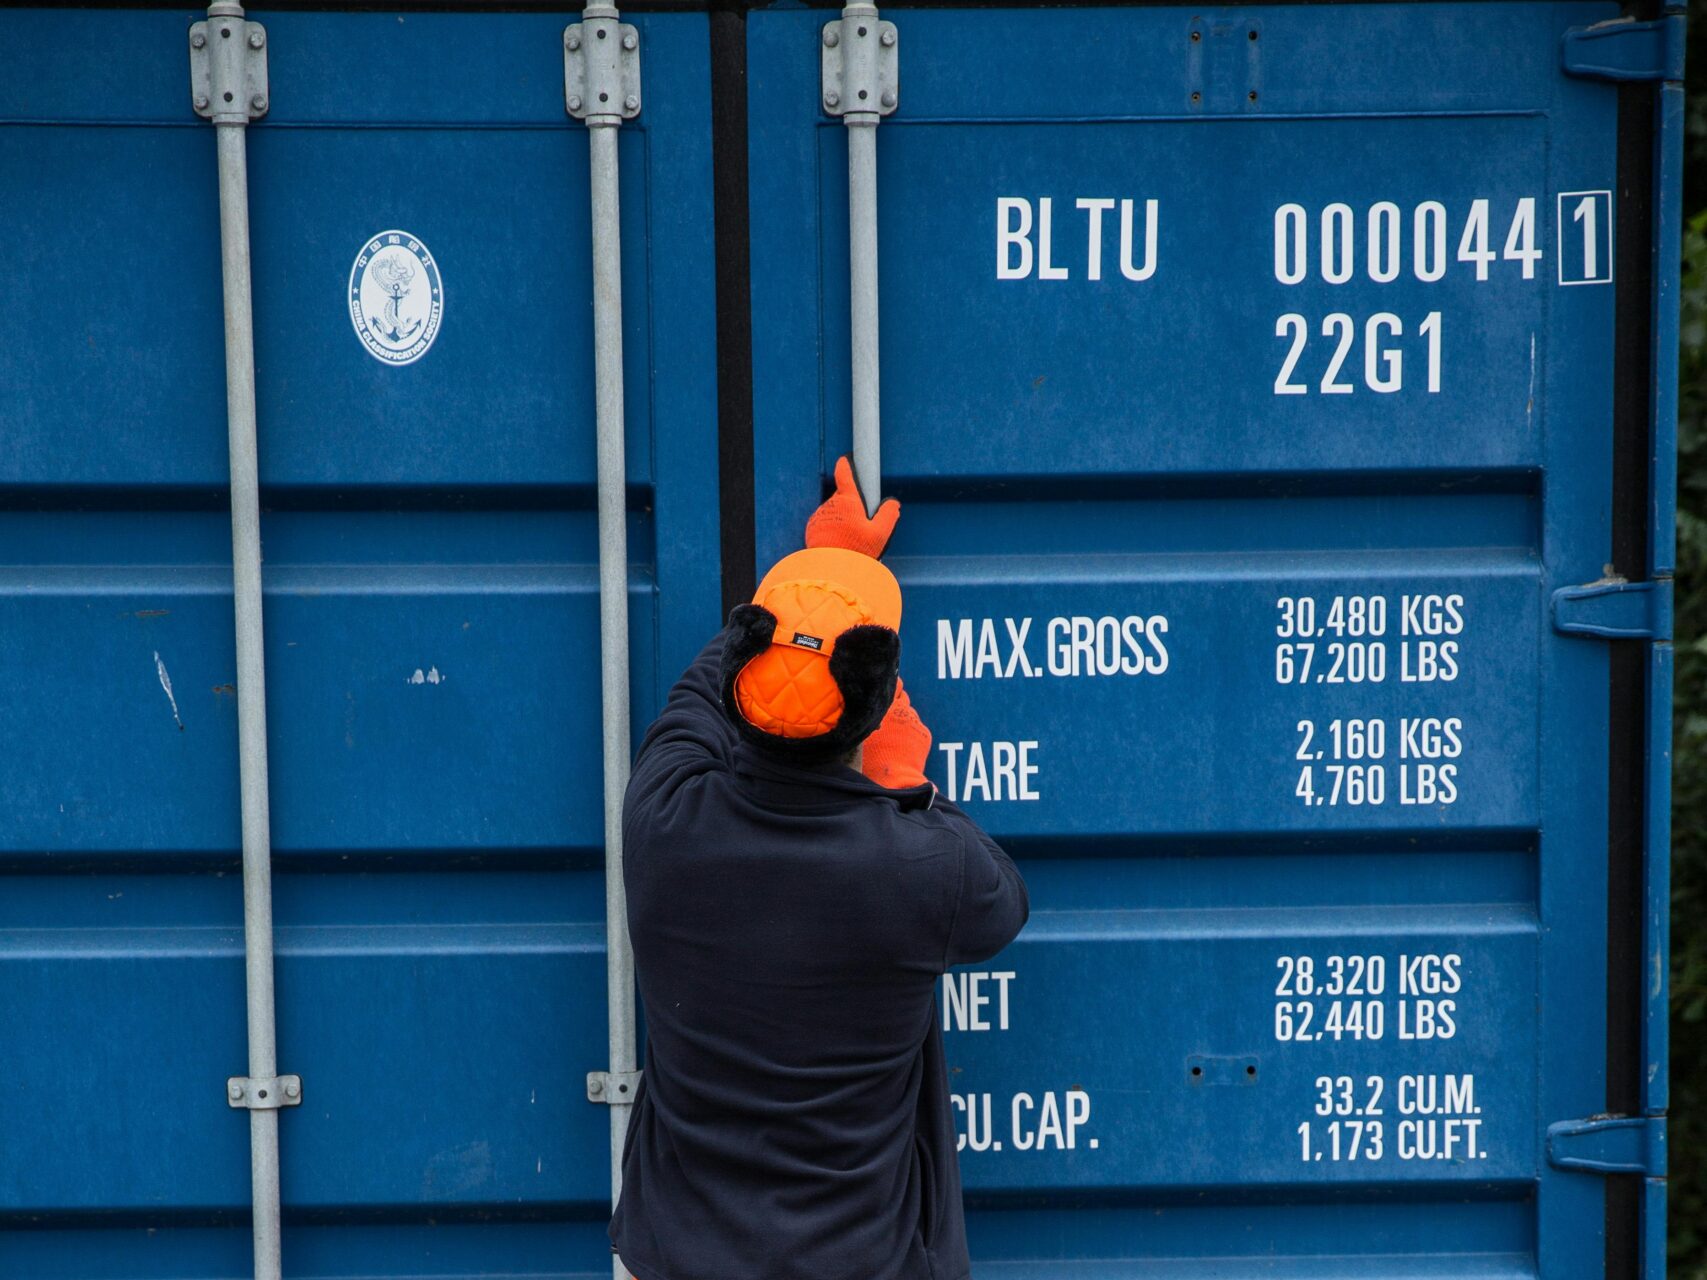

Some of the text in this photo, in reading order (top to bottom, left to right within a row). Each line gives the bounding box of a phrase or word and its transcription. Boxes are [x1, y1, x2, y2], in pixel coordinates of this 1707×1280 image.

[997, 196, 1598, 284] BLTU 000044 1
[352, 301, 440, 359] CHINA CLASSIFICATION SOCIETY
[1275, 312, 1442, 395] 22G1
[1276, 594, 1464, 639] 30,480 KGS
[1276, 641, 1459, 685] 67,200 LBS
[1296, 718, 1463, 761] 2,160 KGS
[939, 741, 1040, 802] TARE
[1296, 764, 1458, 807] 4,760 LBS
[1276, 954, 1461, 997] 28,320 KGS
[943, 971, 1016, 1031] NET
[1275, 1000, 1456, 1042] 62,440 LBS
[1315, 1075, 1481, 1115] 33.2 CU.M.
[1012, 1091, 1099, 1151] CAP.
[1298, 1119, 1487, 1162] 1,173 CU.FT.
